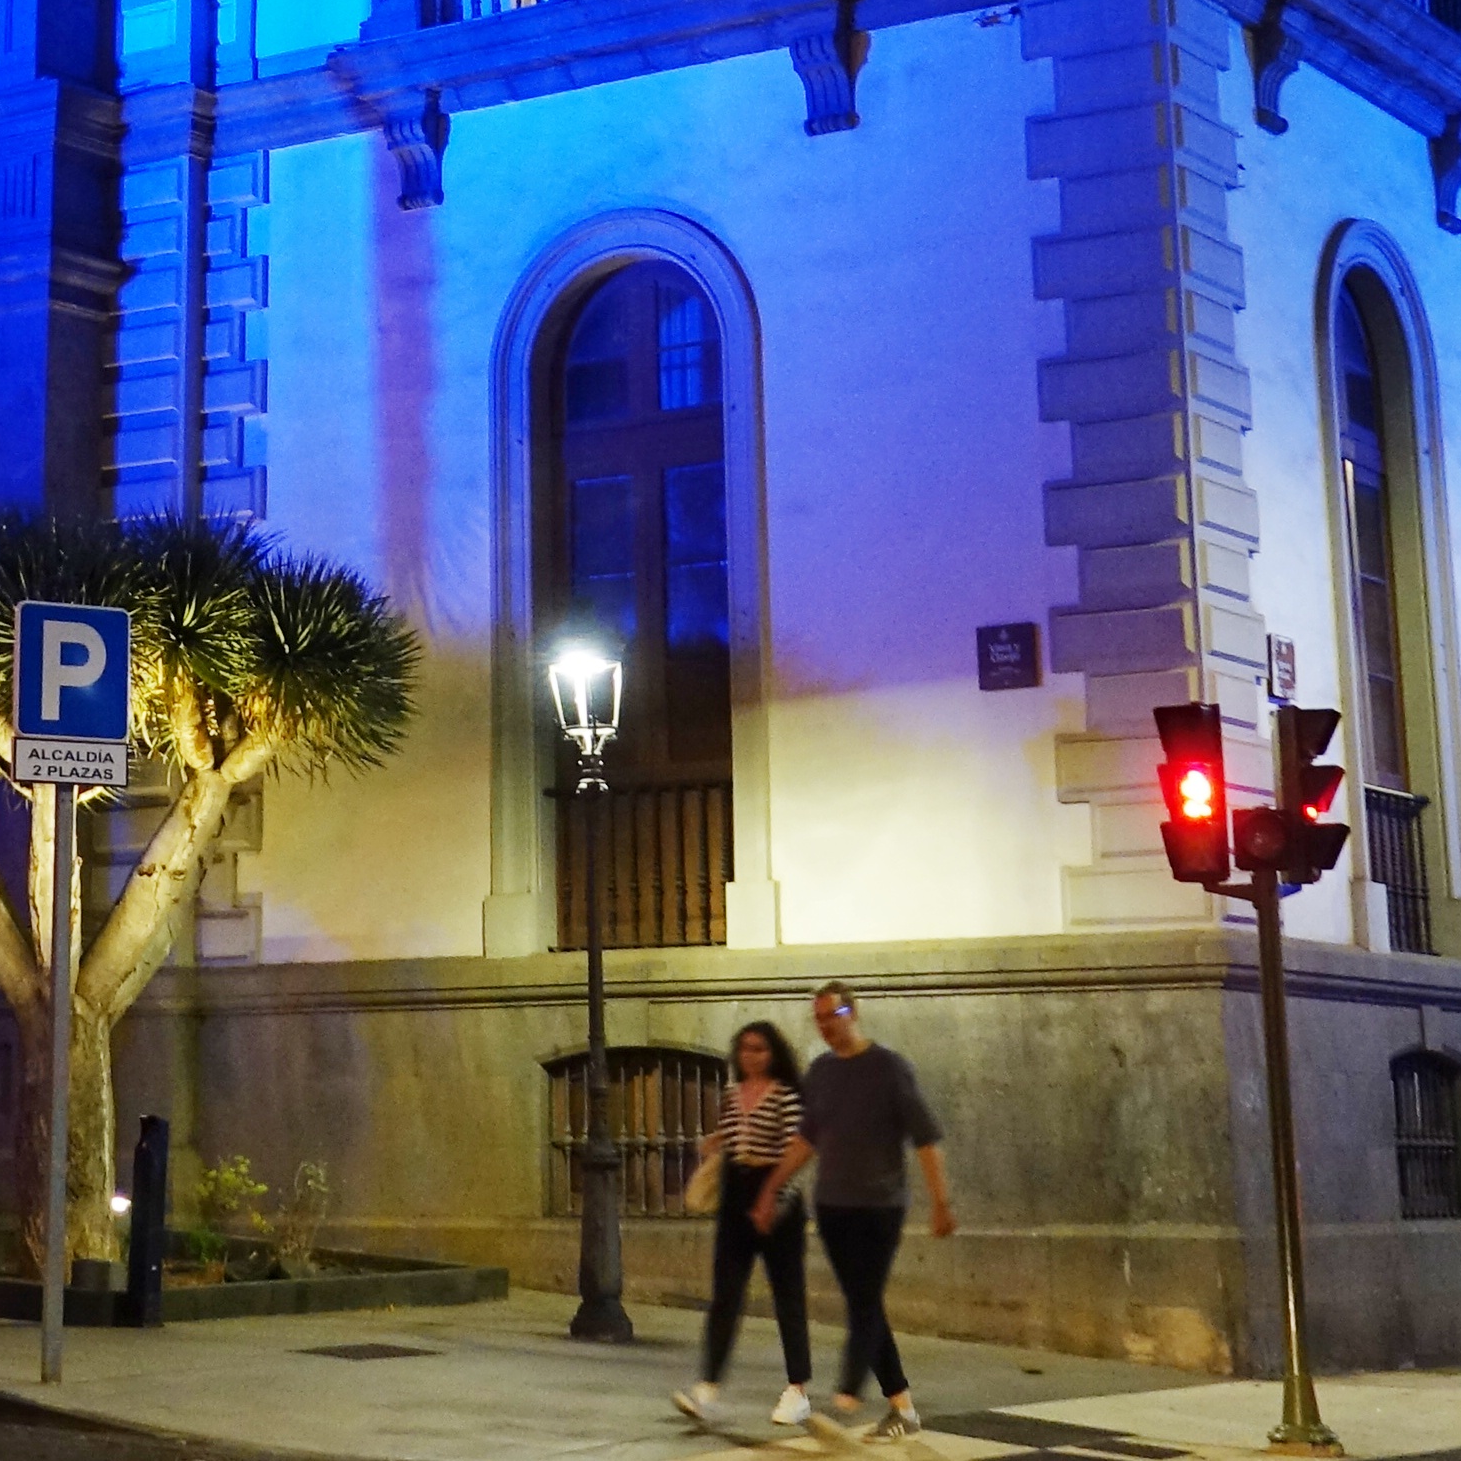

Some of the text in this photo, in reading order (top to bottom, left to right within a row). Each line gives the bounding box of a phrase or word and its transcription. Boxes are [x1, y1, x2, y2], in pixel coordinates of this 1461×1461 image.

[42, 620, 106, 720] P
[28, 748, 114, 764] ALCALDÍA
[32, 764, 114, 780] 2 PLAZAS
